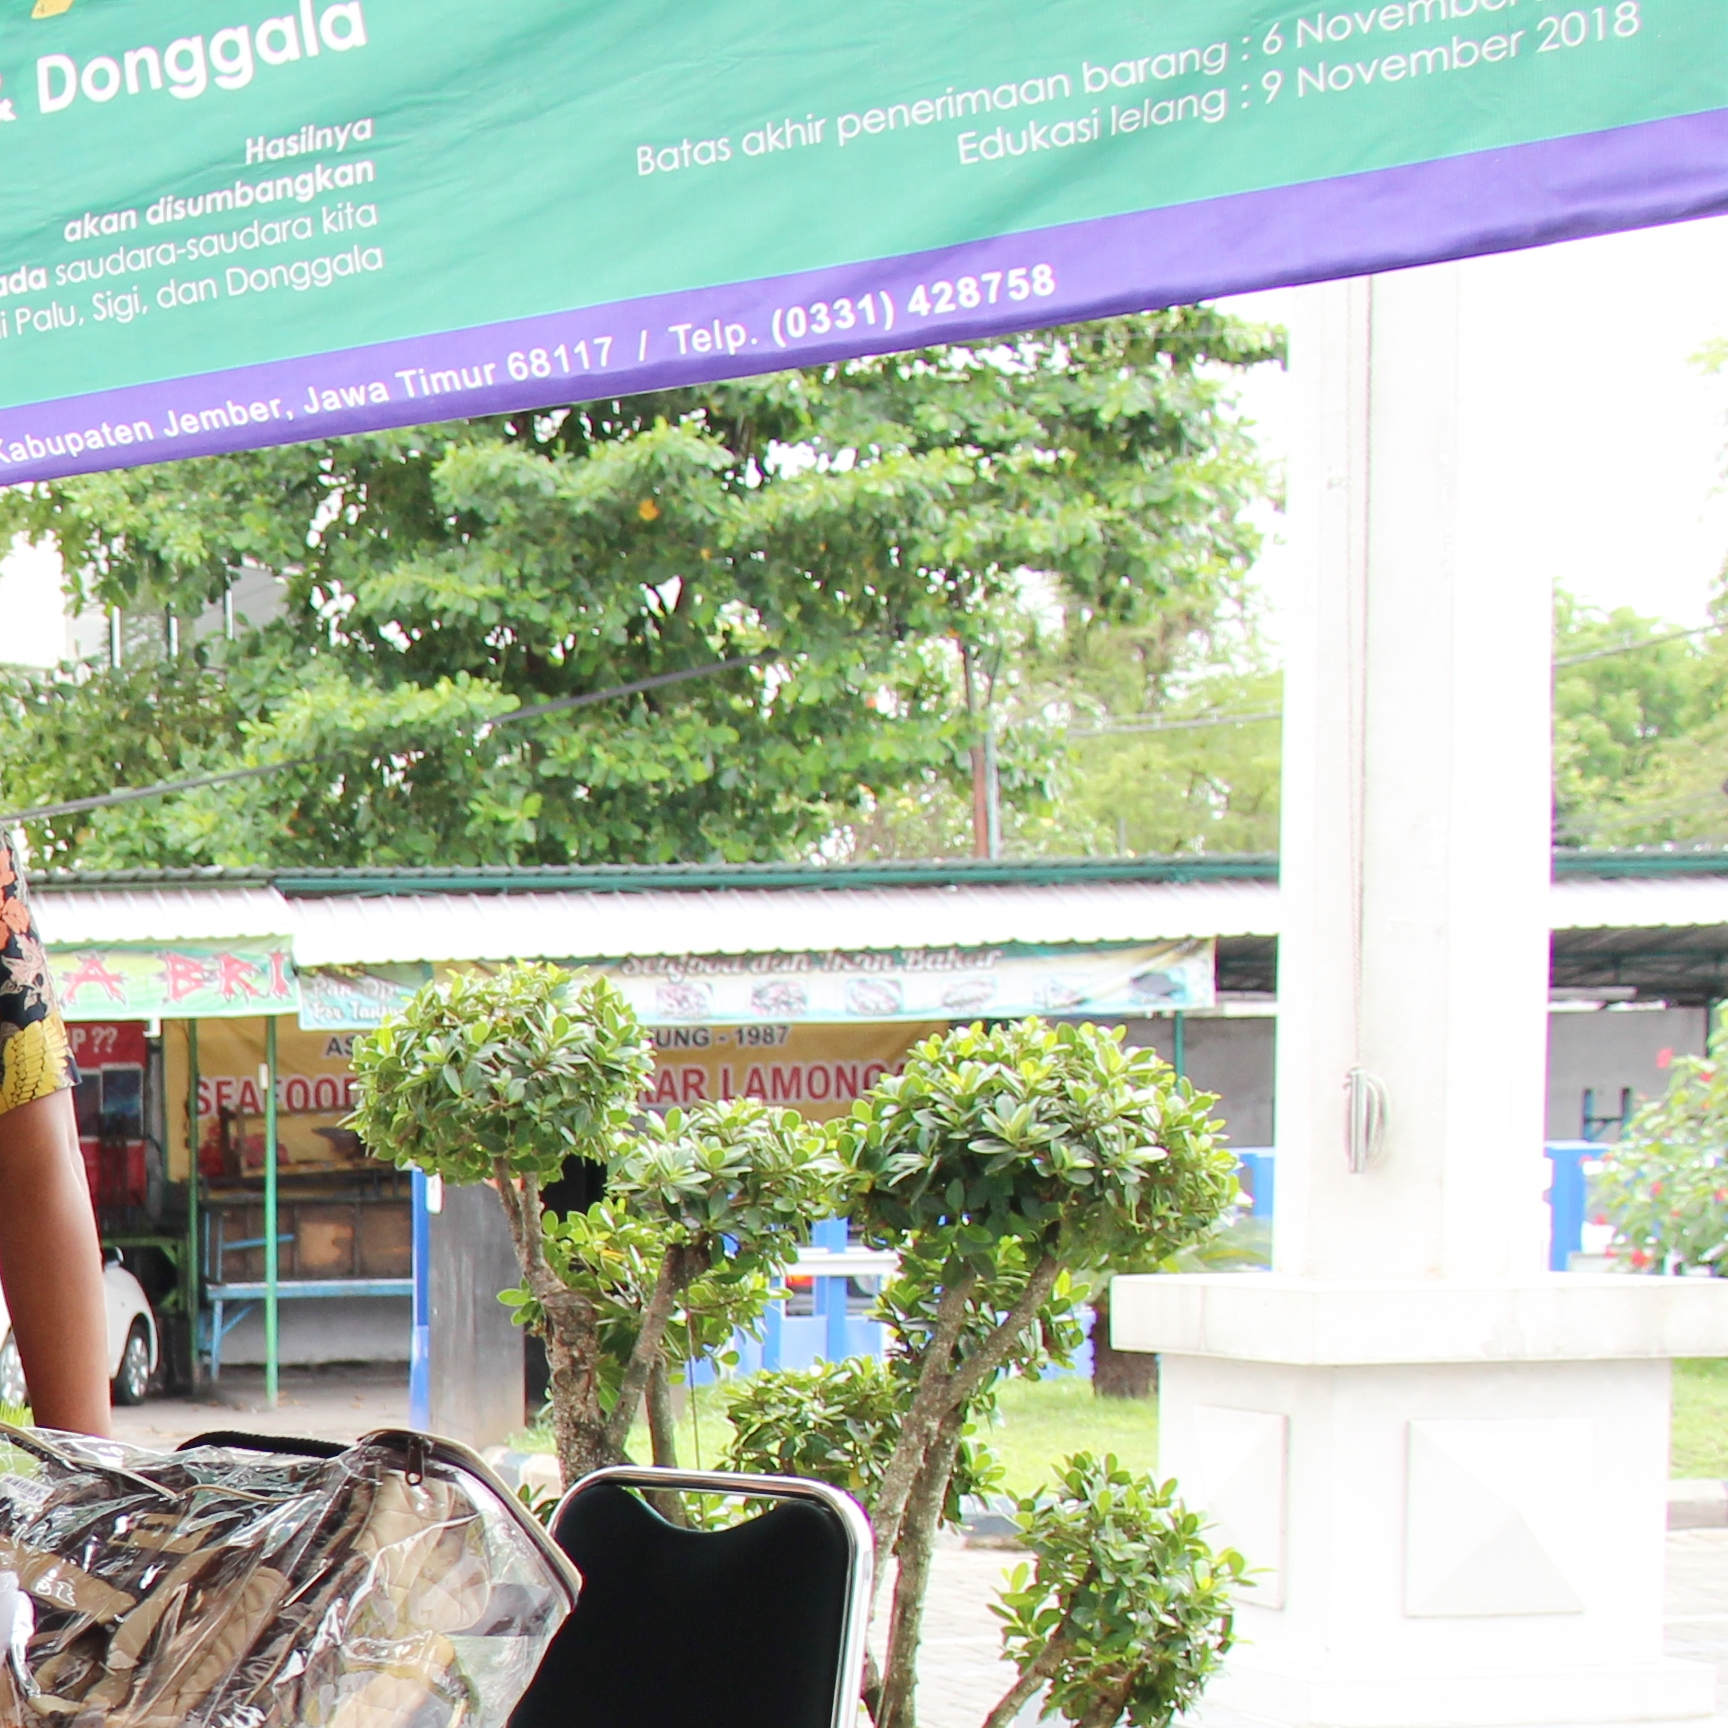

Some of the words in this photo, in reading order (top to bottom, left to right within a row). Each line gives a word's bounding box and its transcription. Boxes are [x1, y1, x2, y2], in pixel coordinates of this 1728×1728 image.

[36, 0, 369, 115] Donggala
[635, 134, 732, 177] Batas
[741, 113, 827, 157] akhir
[837, 73, 1072, 147] penerimaan
[1082, 39, 1228, 94] barang
[1261, 22, 1284, 55] 6
[956, 108, 1099, 165] Edukasi
[1111, 88, 1228, 138] lelang
[1261, 70, 1284, 106] 9
[1297, 26, 1527, 98] November
[1536, 1, 1643, 54] 2018
[244, 115, 374, 167] Hasilnya
[54, 215, 313, 289] saudara-saudara
[321, 199, 379, 238] kita
[63, 210, 137, 244] akan
[146, 157, 375, 227] disumbangkan
[15, 296, 85, 337] Palu,
[92, 285, 148, 325] Sigi,
[156, 276, 218, 310] dan
[227, 242, 385, 297] Donggala
[163, 394, 295, 440] Jember,
[302, 381, 390, 415] Jawa
[394, 360, 496, 400] Timur
[507, 335, 614, 382] 68117
[668, 317, 759, 356] Telp.
[772, 290, 895, 348] (0331)
[907, 264, 1058, 318] 428758
[734, 1025, 790, 1047] 1987
